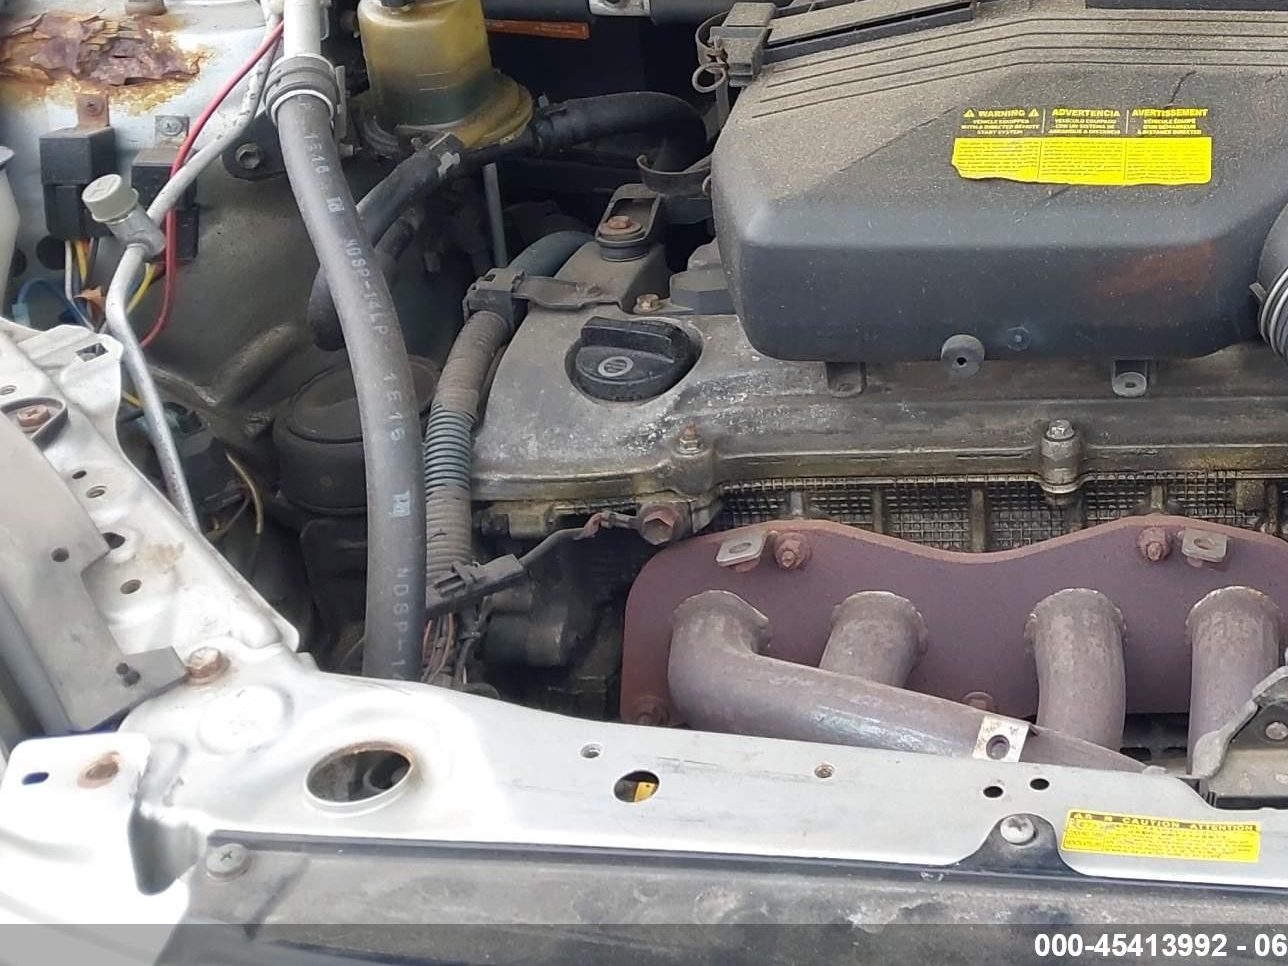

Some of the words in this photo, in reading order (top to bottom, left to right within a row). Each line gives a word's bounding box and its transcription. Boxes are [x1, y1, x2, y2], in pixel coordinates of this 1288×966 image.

[978, 109, 1026, 117] WARNING
[1052, 108, 1121, 117] ADVERTENCIA
[1131, 108, 1209, 117] AVERTISSEMENT
[1121, 817, 1180, 829] CAUTION
[1189, 822, 1255, 832] ATTENTION
